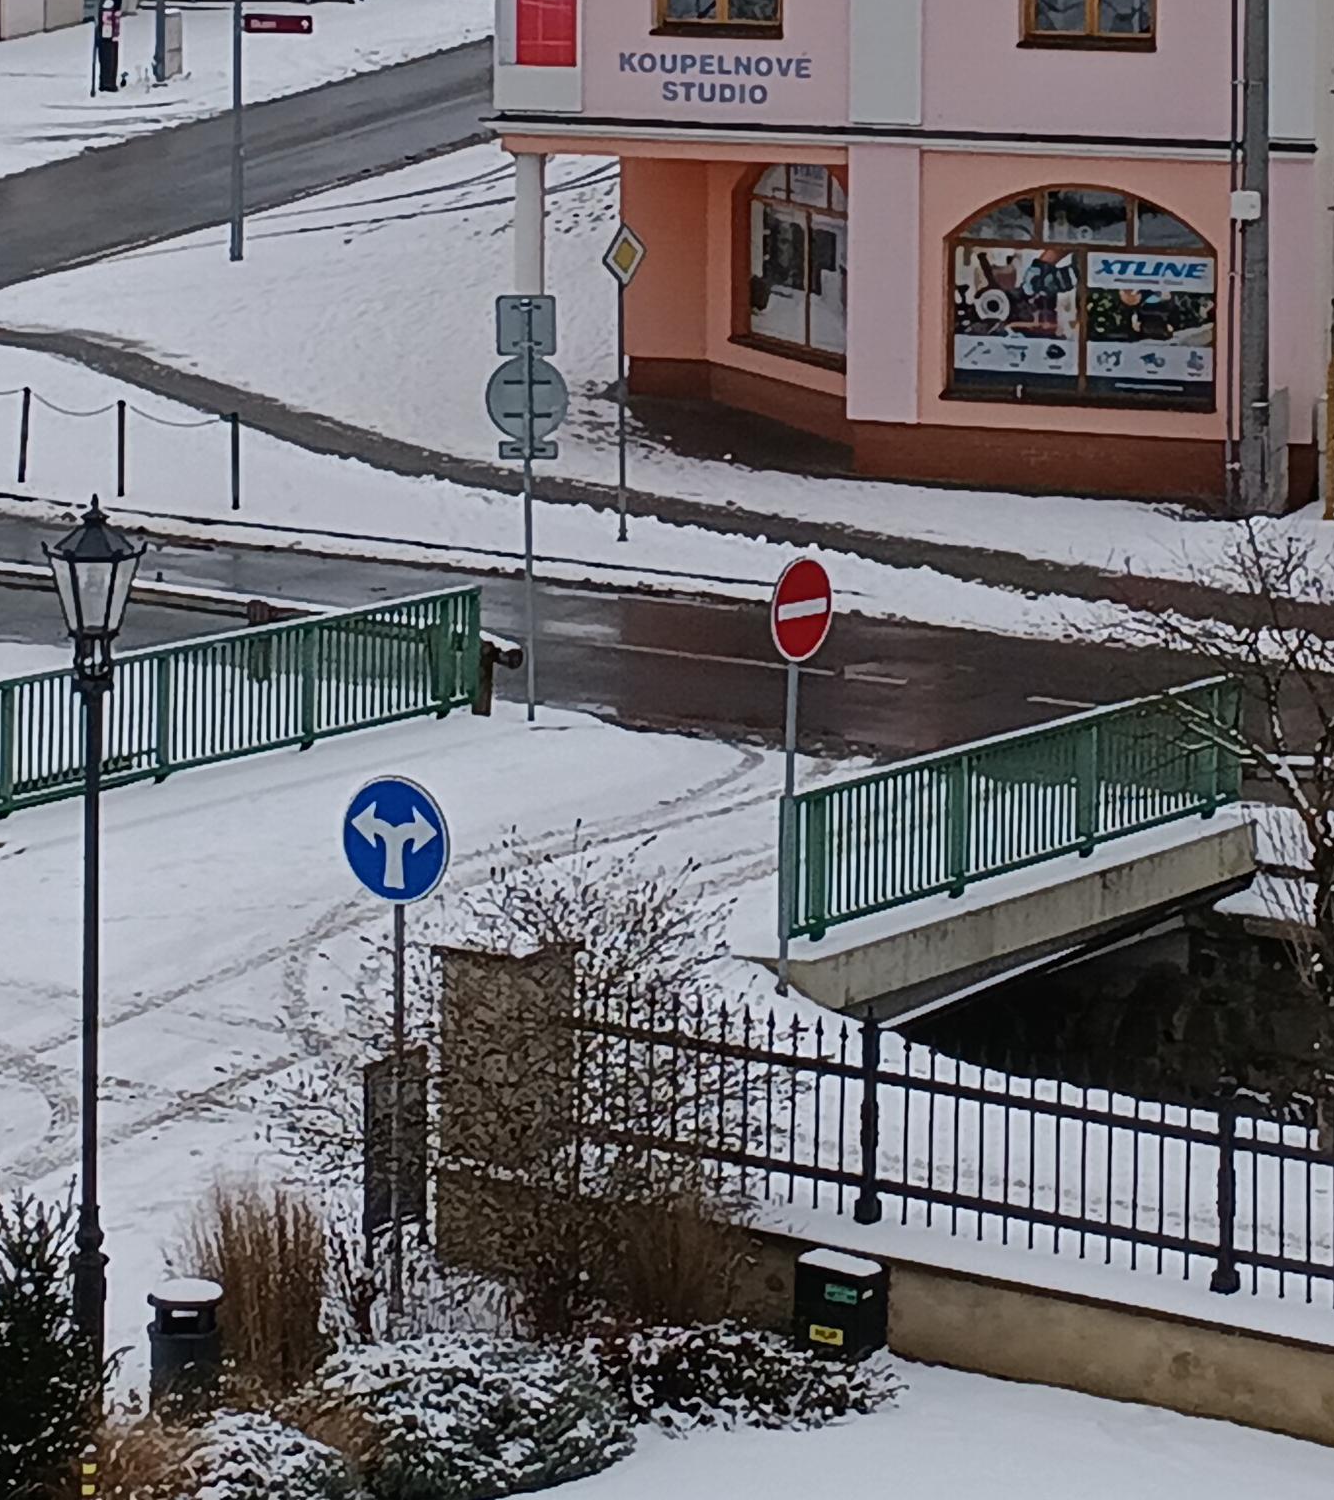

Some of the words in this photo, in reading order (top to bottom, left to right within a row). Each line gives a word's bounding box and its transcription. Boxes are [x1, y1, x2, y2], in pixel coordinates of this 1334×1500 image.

[618, 51, 813, 79] KOUPELNOVÉ
[661, 81, 769, 105] STUDIO
[1095, 259, 1208, 279] XTLINE
